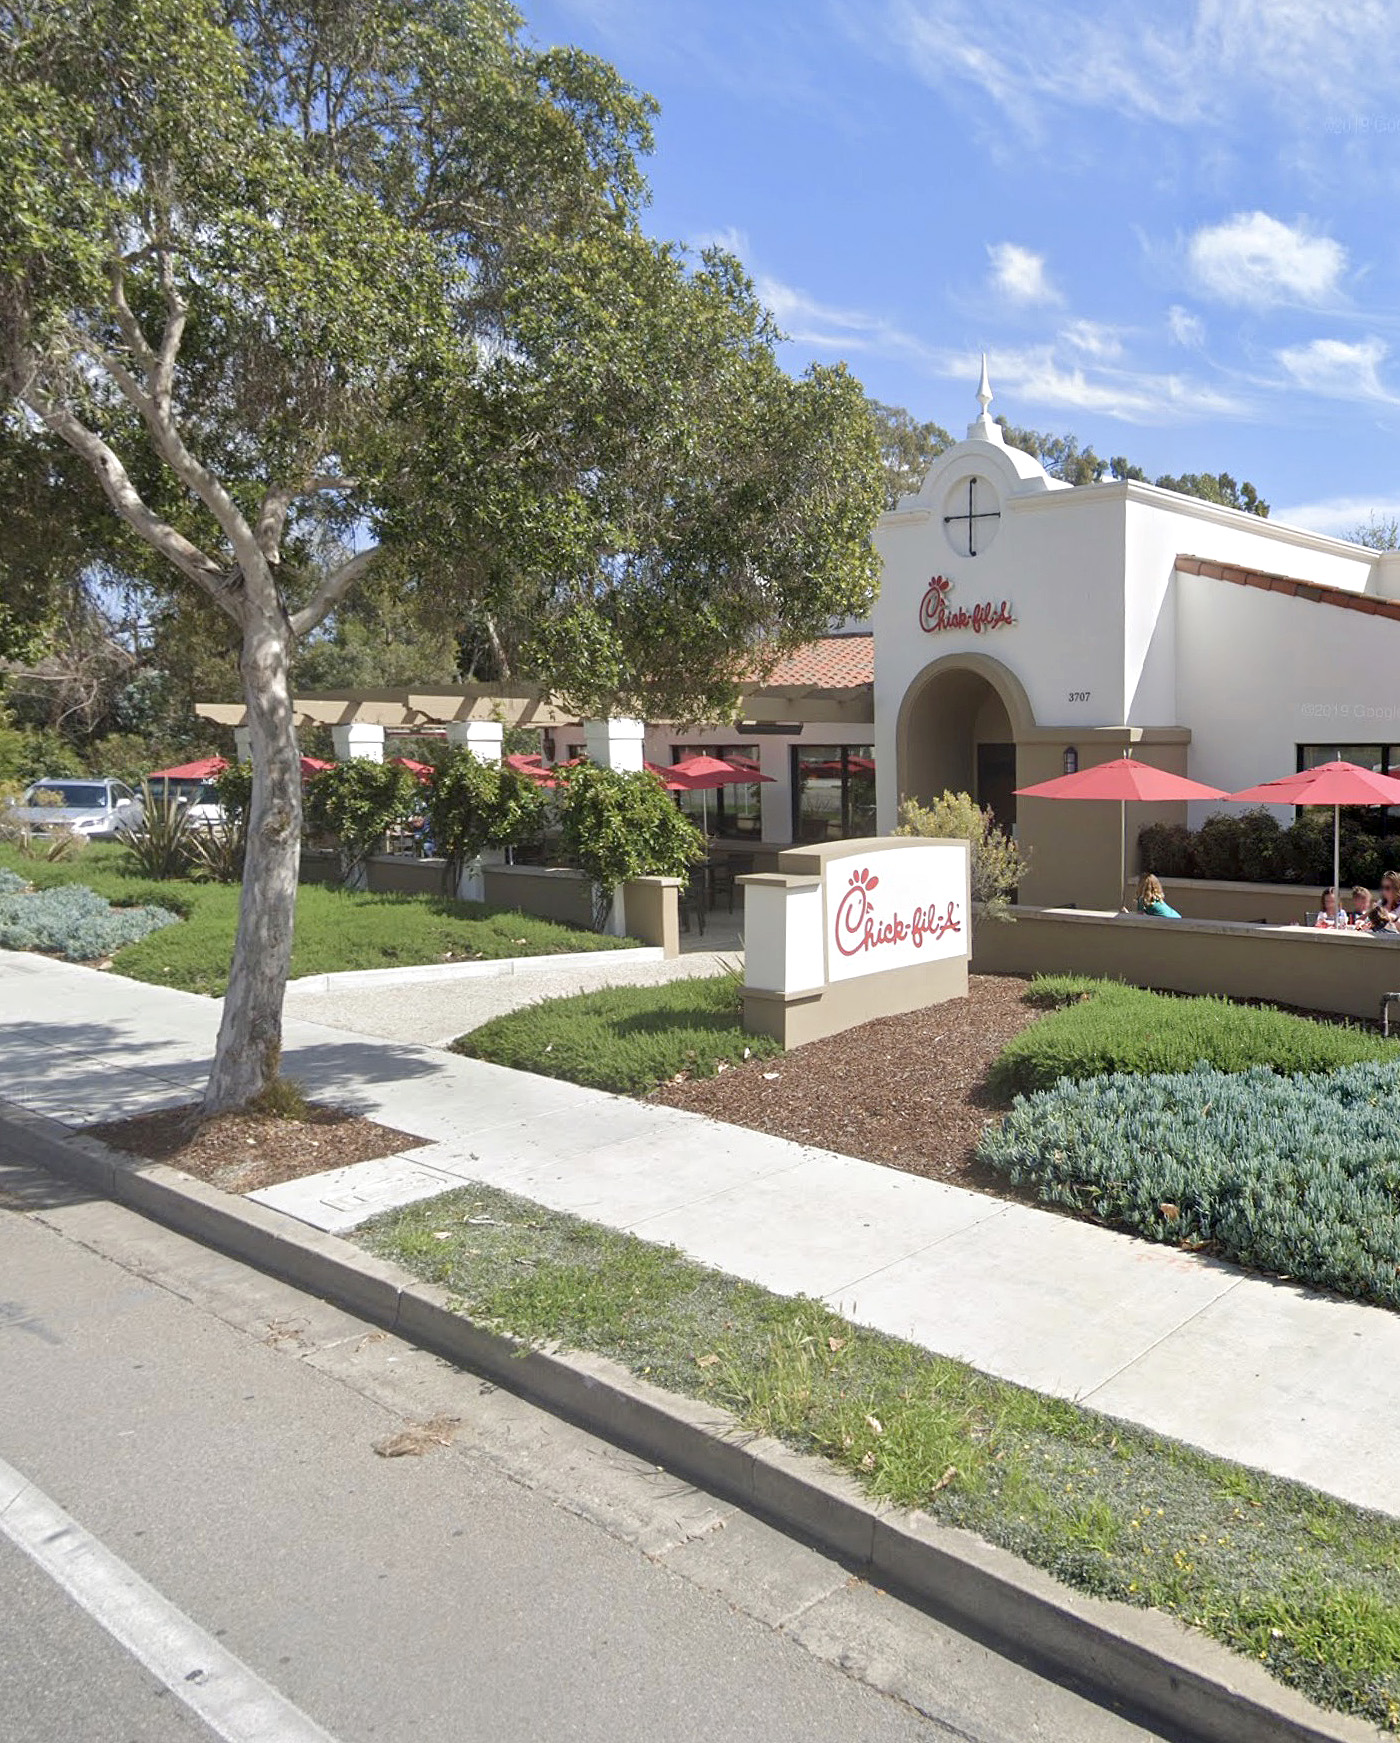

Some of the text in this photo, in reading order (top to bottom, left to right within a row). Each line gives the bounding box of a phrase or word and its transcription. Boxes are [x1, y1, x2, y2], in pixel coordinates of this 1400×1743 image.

[919, 575, 1013, 634] Chick-fil-A
[1068, 691, 1091, 702] 3707
[835, 867, 961, 956] Chick-fil-A
